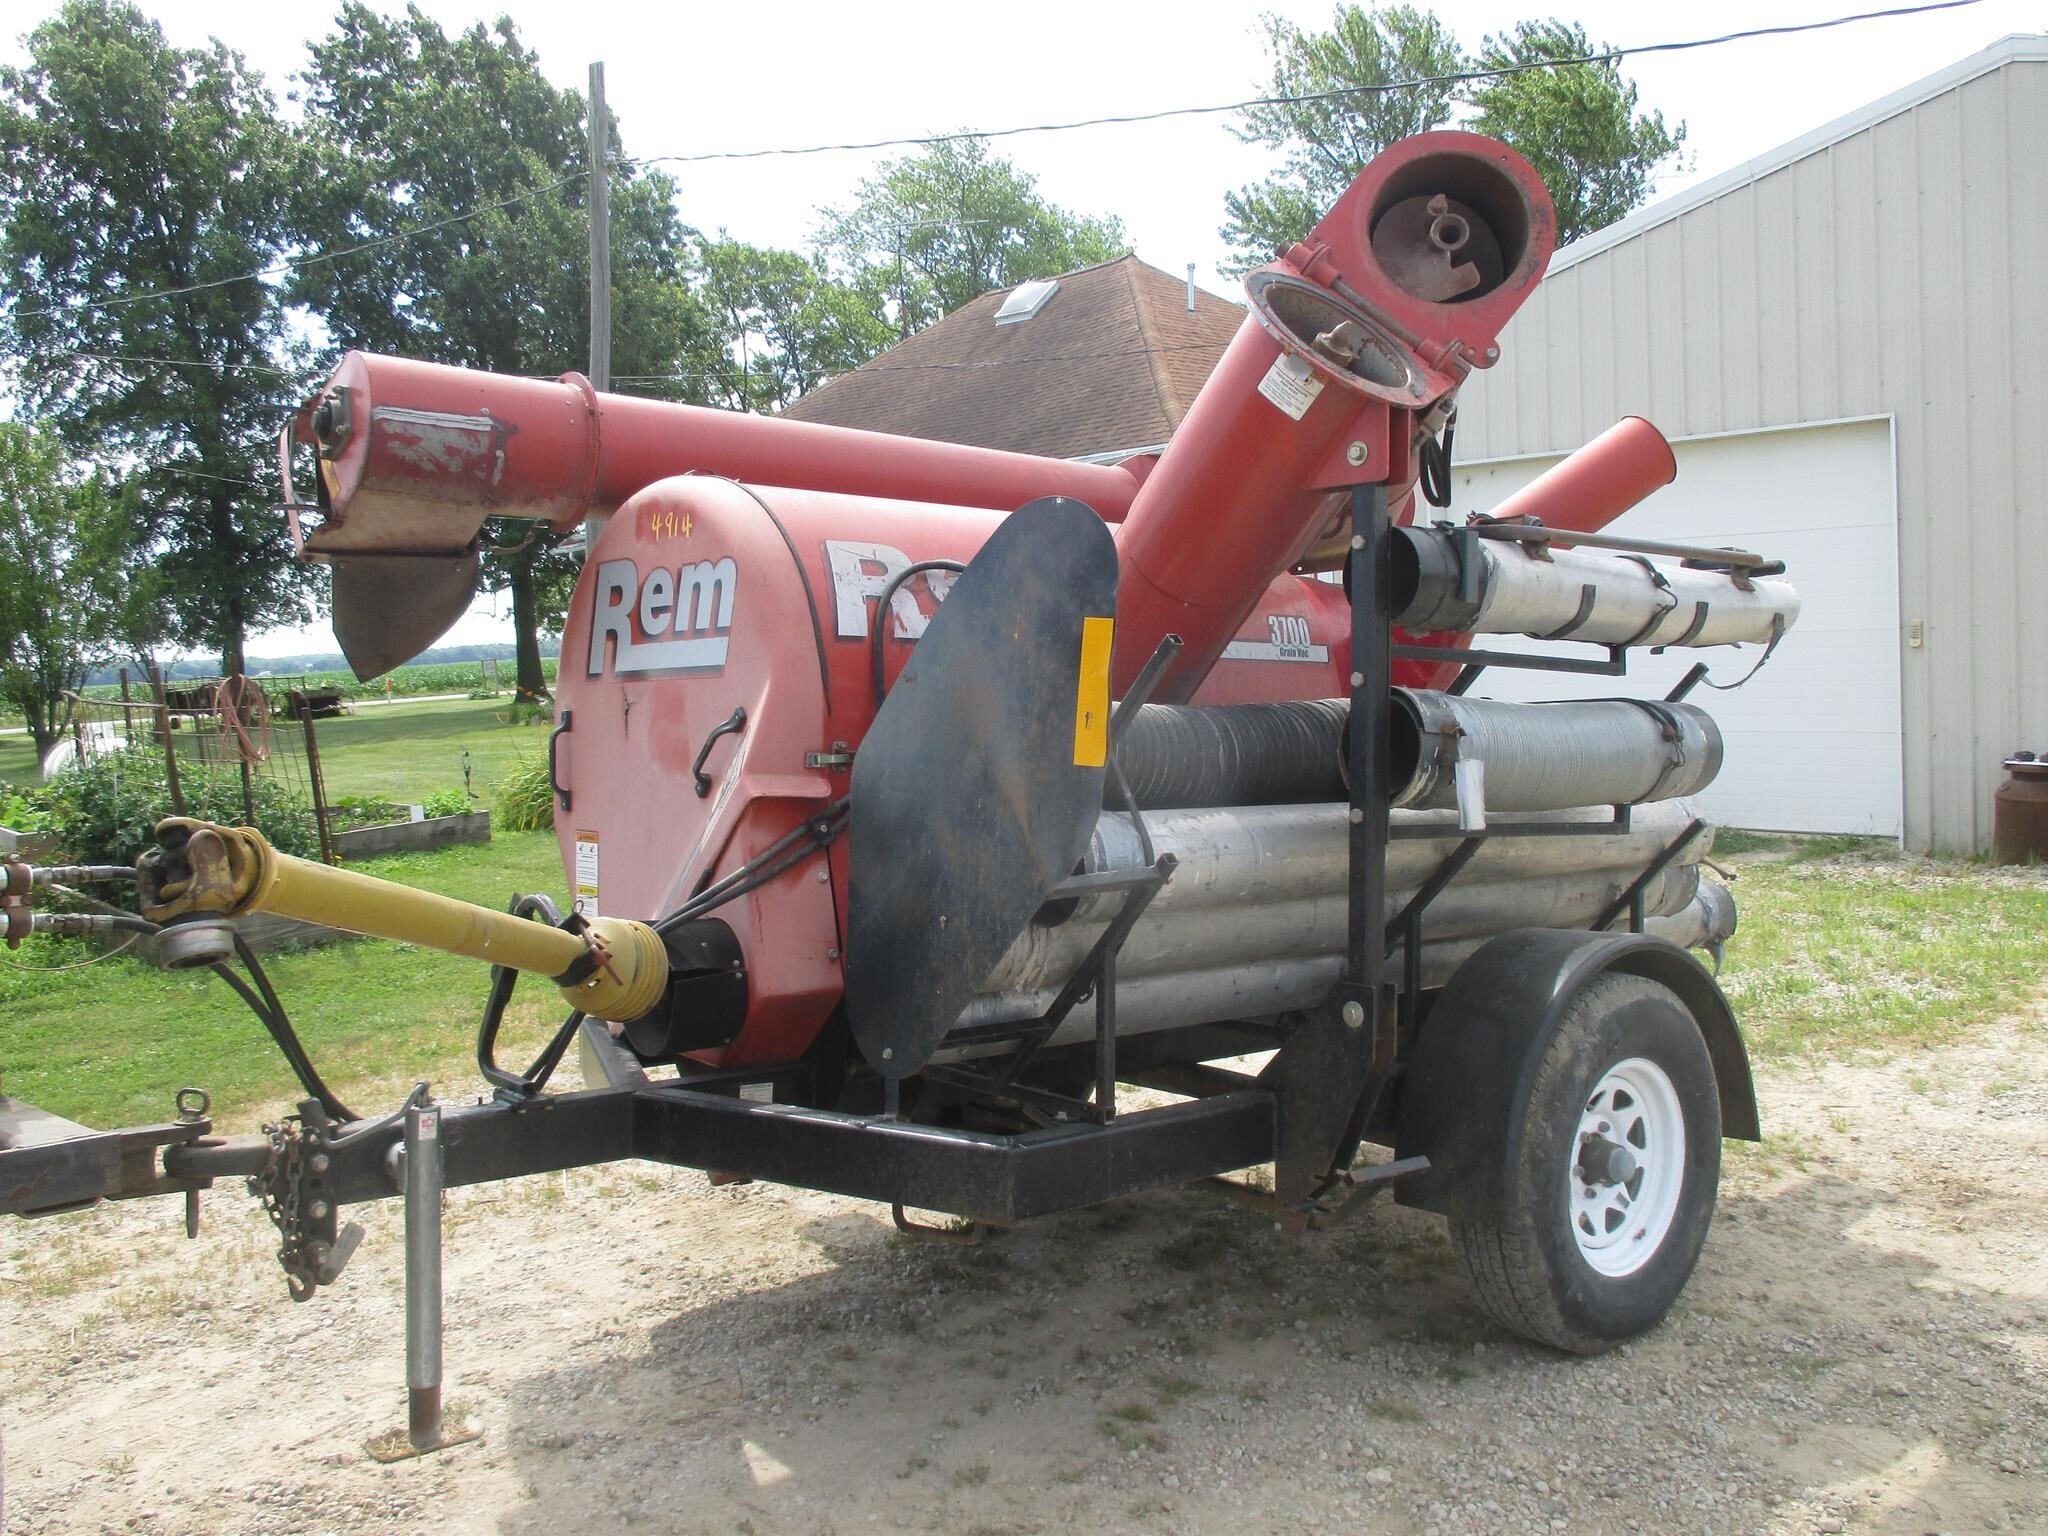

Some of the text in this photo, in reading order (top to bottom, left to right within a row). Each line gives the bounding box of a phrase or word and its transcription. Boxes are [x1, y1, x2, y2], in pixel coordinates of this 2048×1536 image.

[651, 512, 693, 541] 4914
[588, 557, 737, 676] Rem
[1268, 615, 1311, 647] 3700
[1280, 647, 1309, 658] Grain Vac
